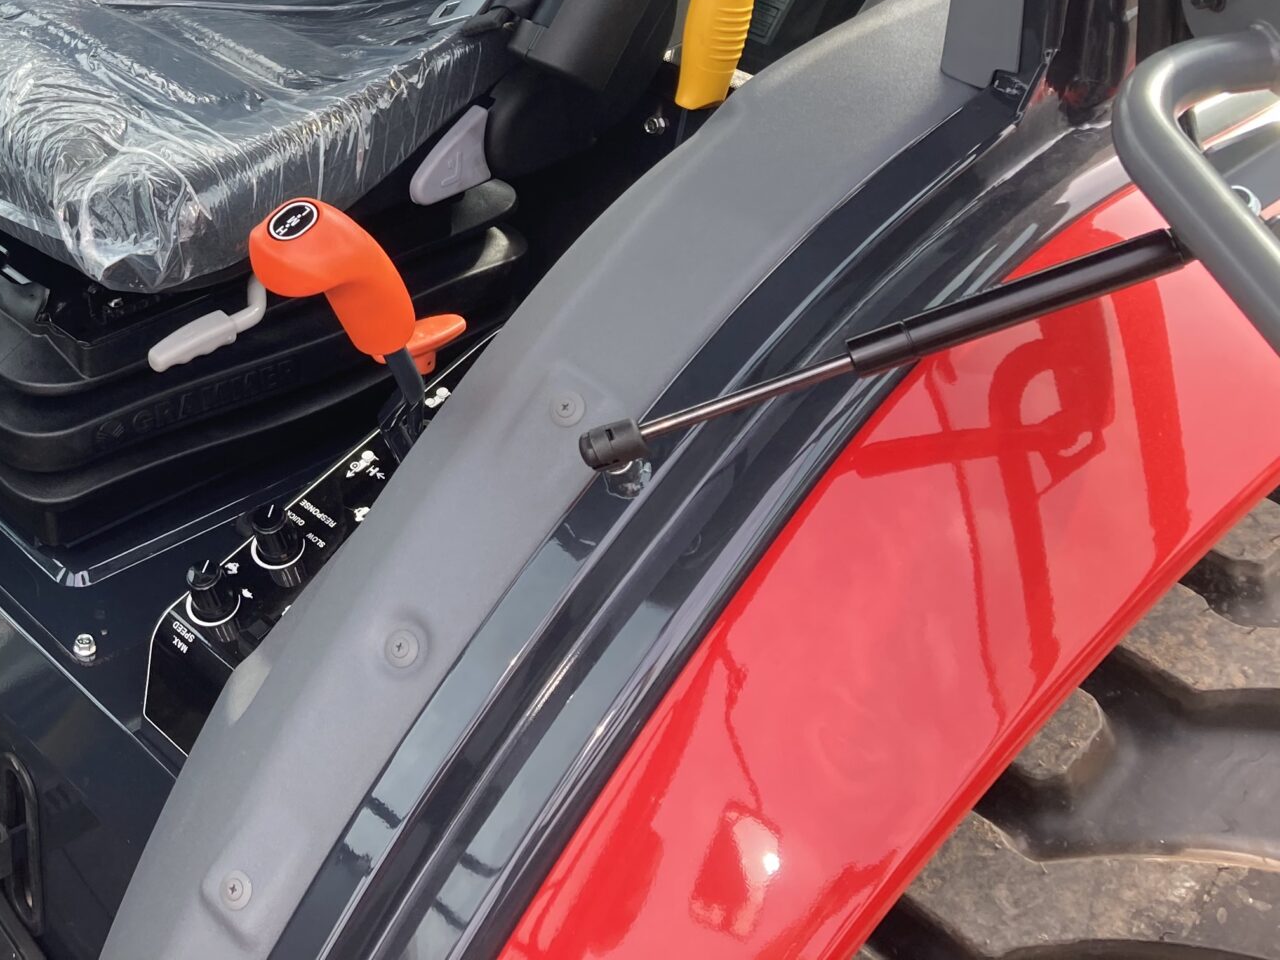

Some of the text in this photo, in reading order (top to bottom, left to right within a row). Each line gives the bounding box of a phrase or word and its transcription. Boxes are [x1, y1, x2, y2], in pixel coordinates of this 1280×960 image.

[300, 499, 337, 528] RESPONSE
[306, 532, 326, 548] SLOW
[172, 621, 195, 642] SPEED
